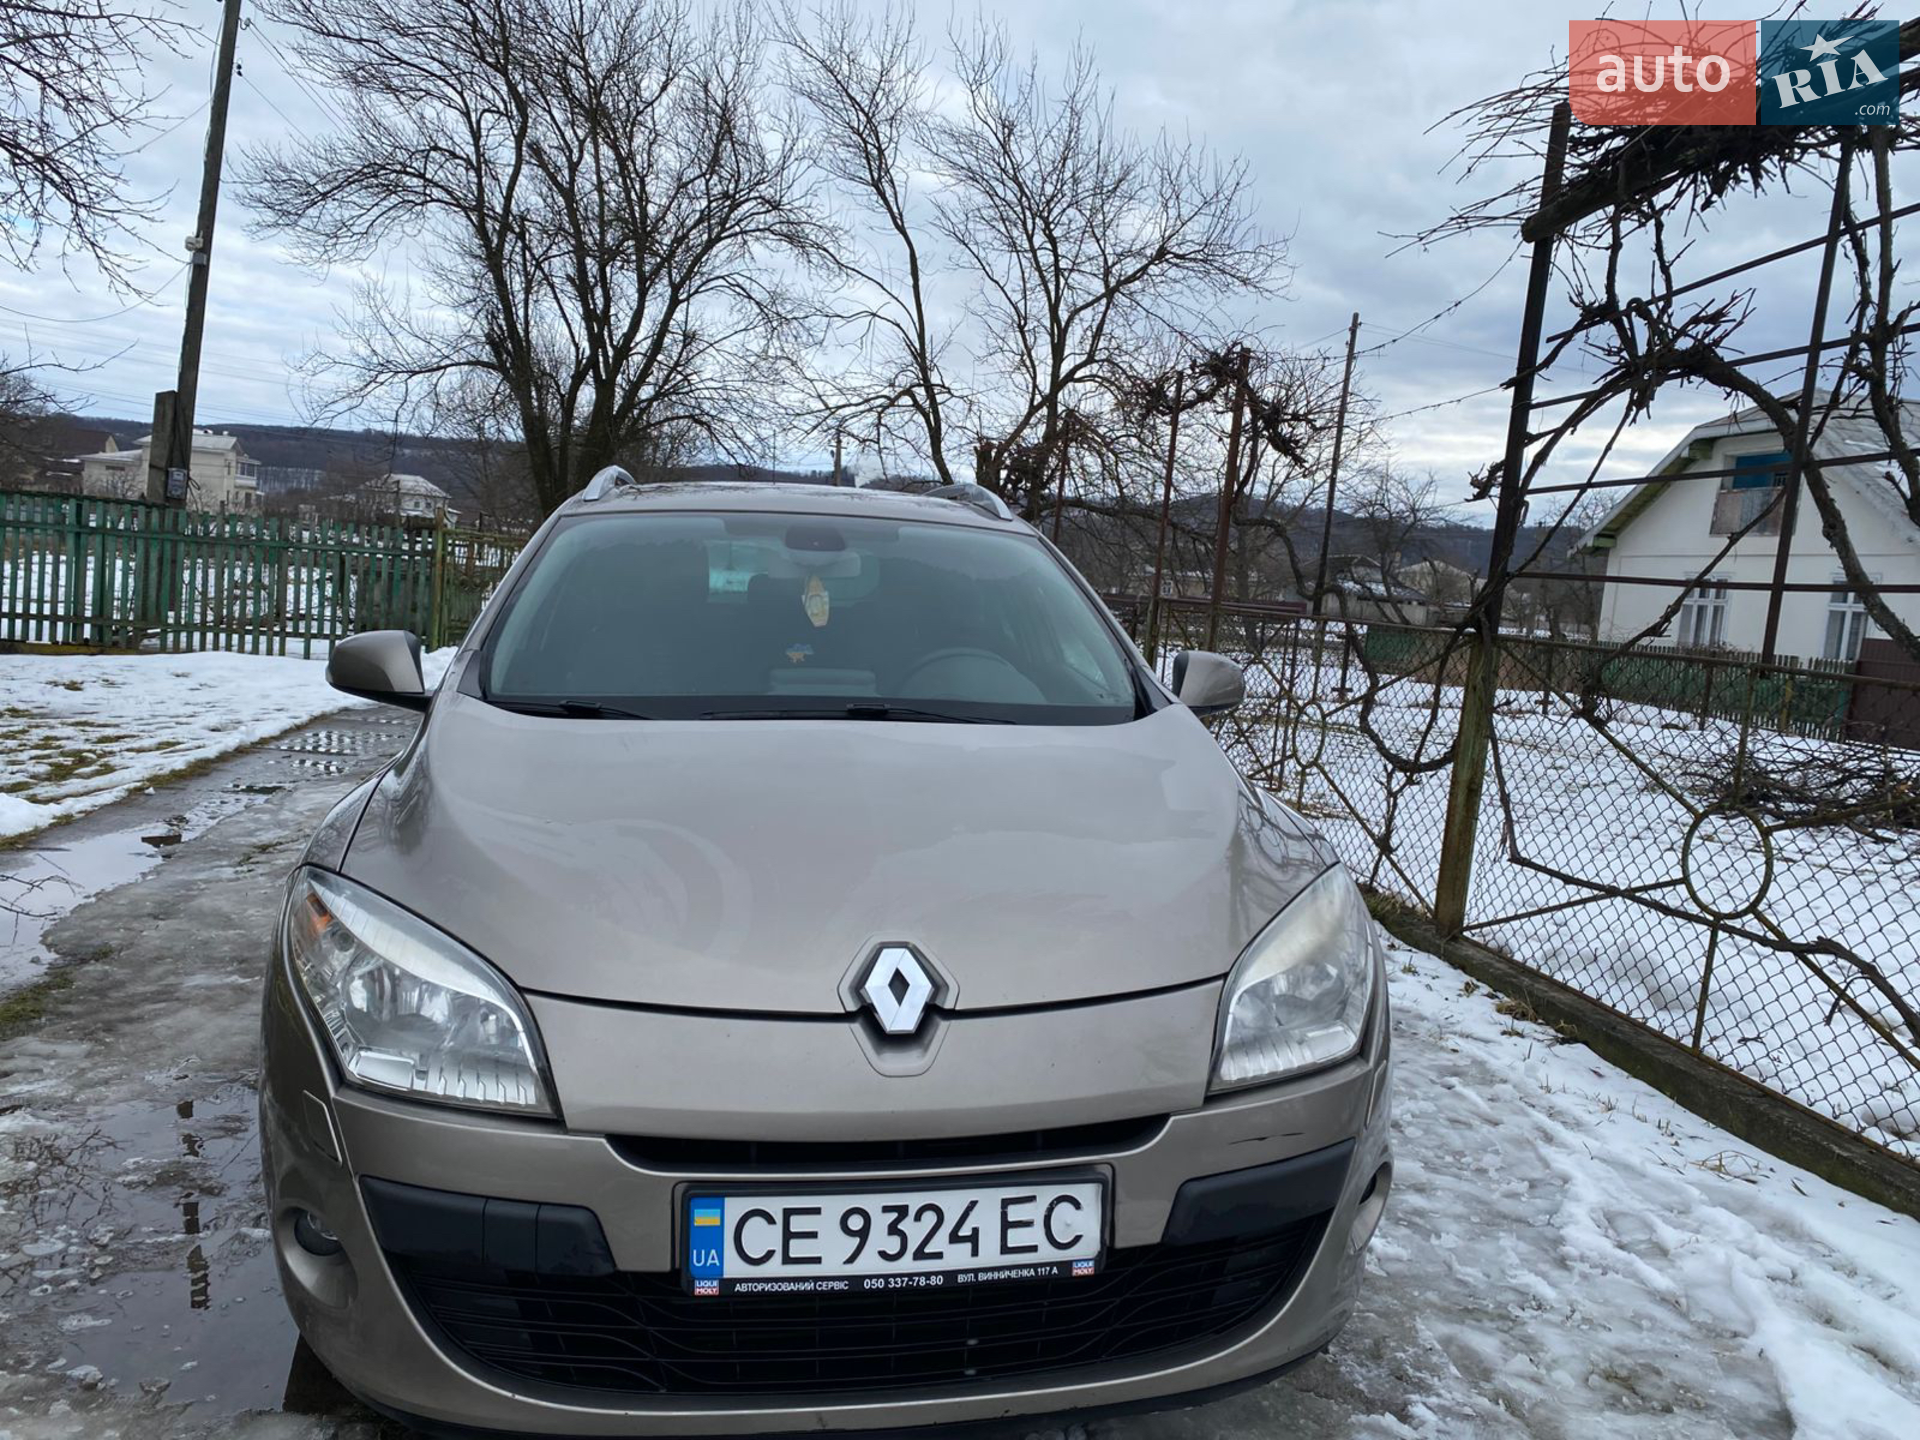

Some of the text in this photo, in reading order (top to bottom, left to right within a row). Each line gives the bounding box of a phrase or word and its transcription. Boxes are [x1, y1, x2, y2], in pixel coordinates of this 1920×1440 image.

[733, 1194, 1084, 1267] CE 9324 EC
[693, 1249, 720, 1267] UA
[978, 1267, 1036, 1281] ВИННИЧЕНКА
[1037, 1266, 1050, 1276] 117
[734, 1279, 849, 1292] АВТОРИЗОВАНИЙ СЕРВІС
[863, 1275, 944, 1289] 050 337-78-80
